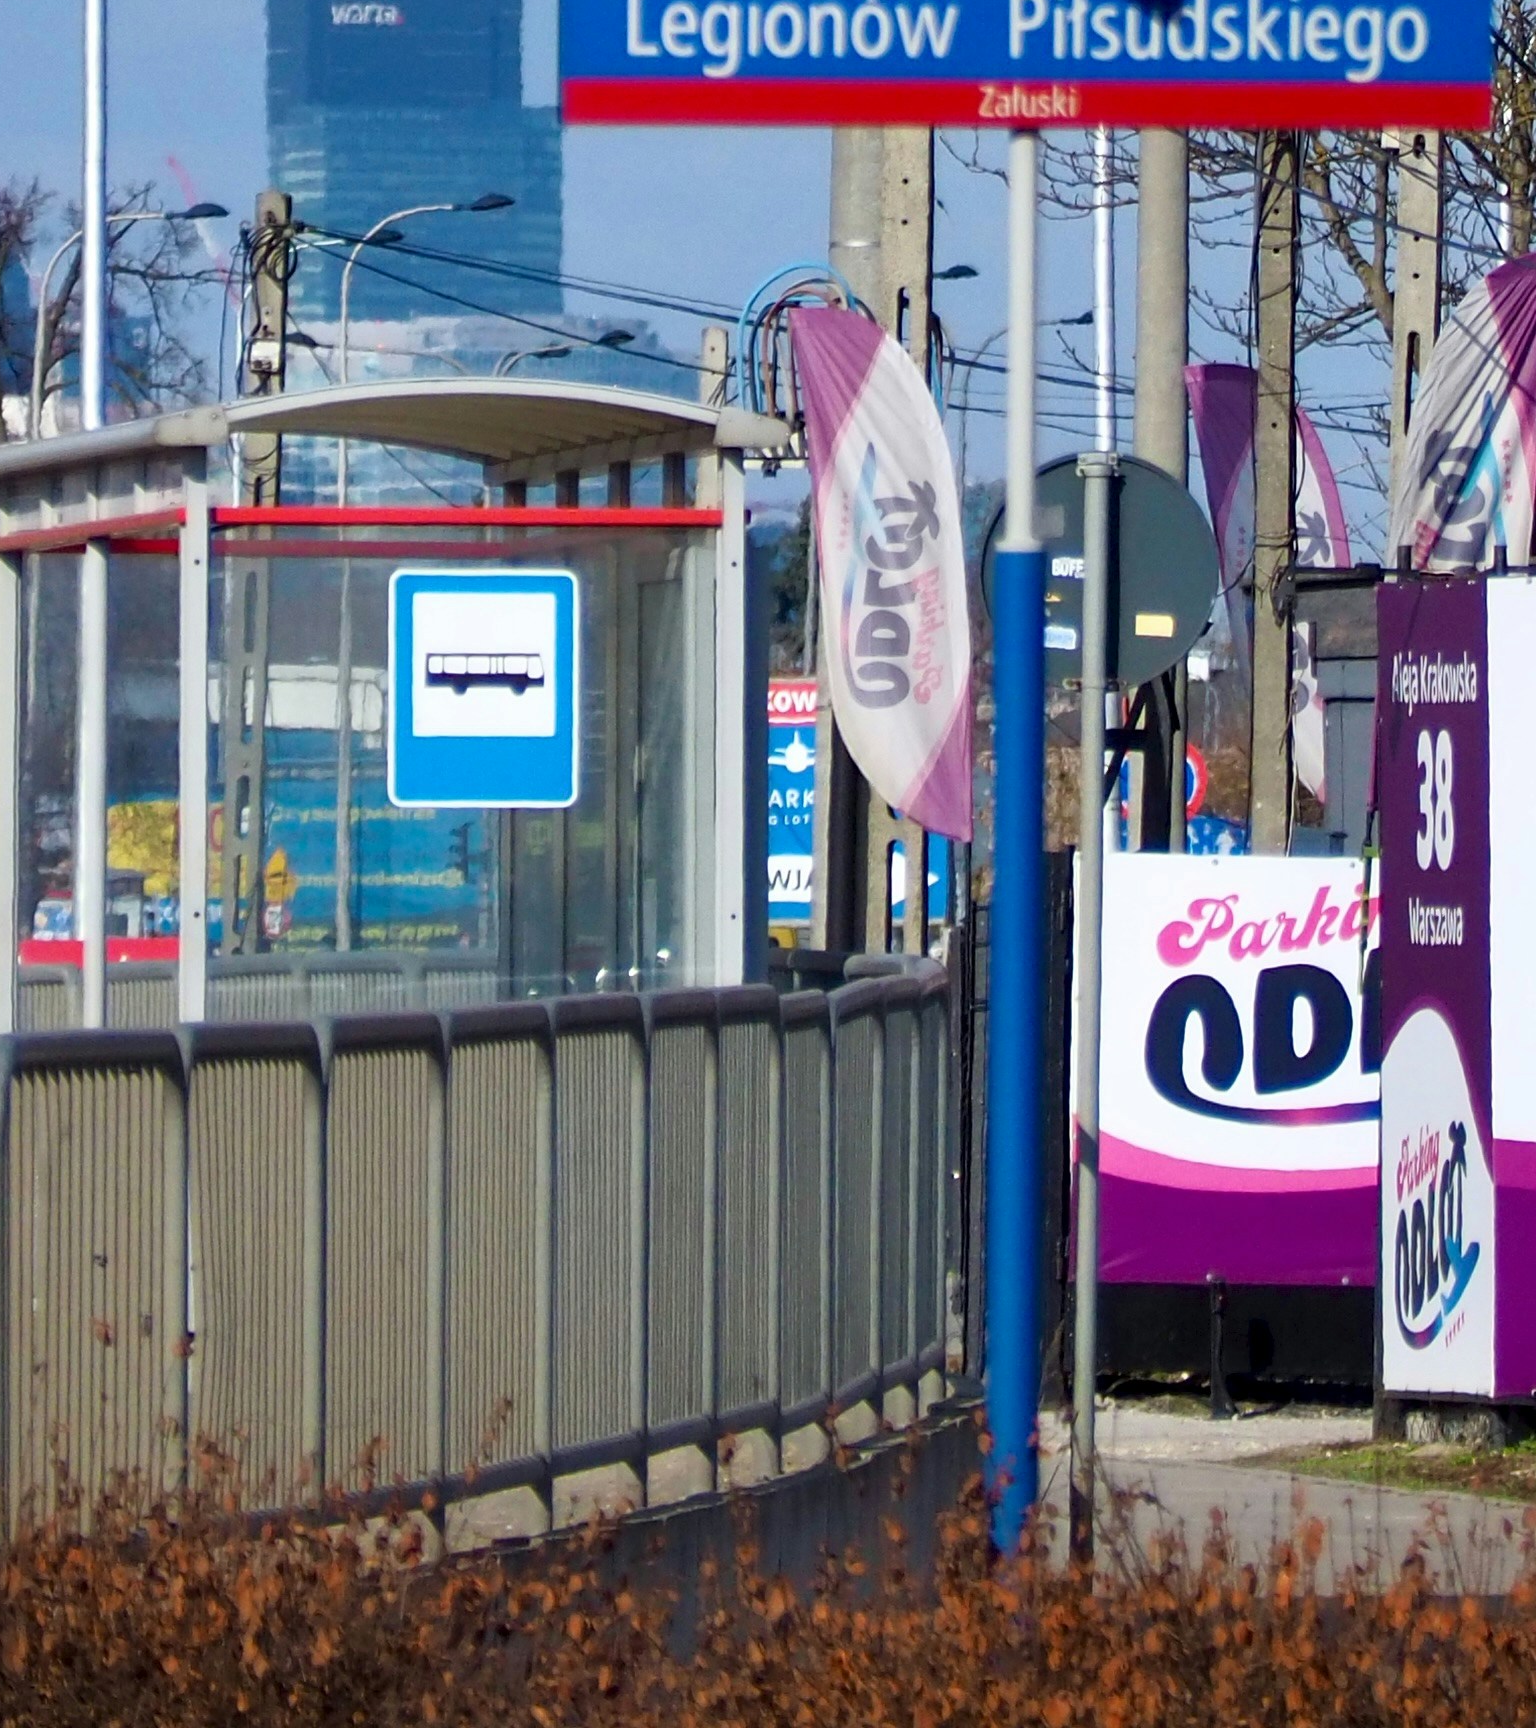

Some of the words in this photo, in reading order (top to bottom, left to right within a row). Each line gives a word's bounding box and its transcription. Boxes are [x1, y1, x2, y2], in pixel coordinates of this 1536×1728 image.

[978, 85, 1078, 118] Załuski
[1392, 651, 1419, 717] Aleja
[1420, 651, 1477, 704] Krakowska
[1416, 730, 1455, 871] 38
[1408, 897, 1464, 946] Warszawa
[1398, 1123, 1440, 1206] Parking
